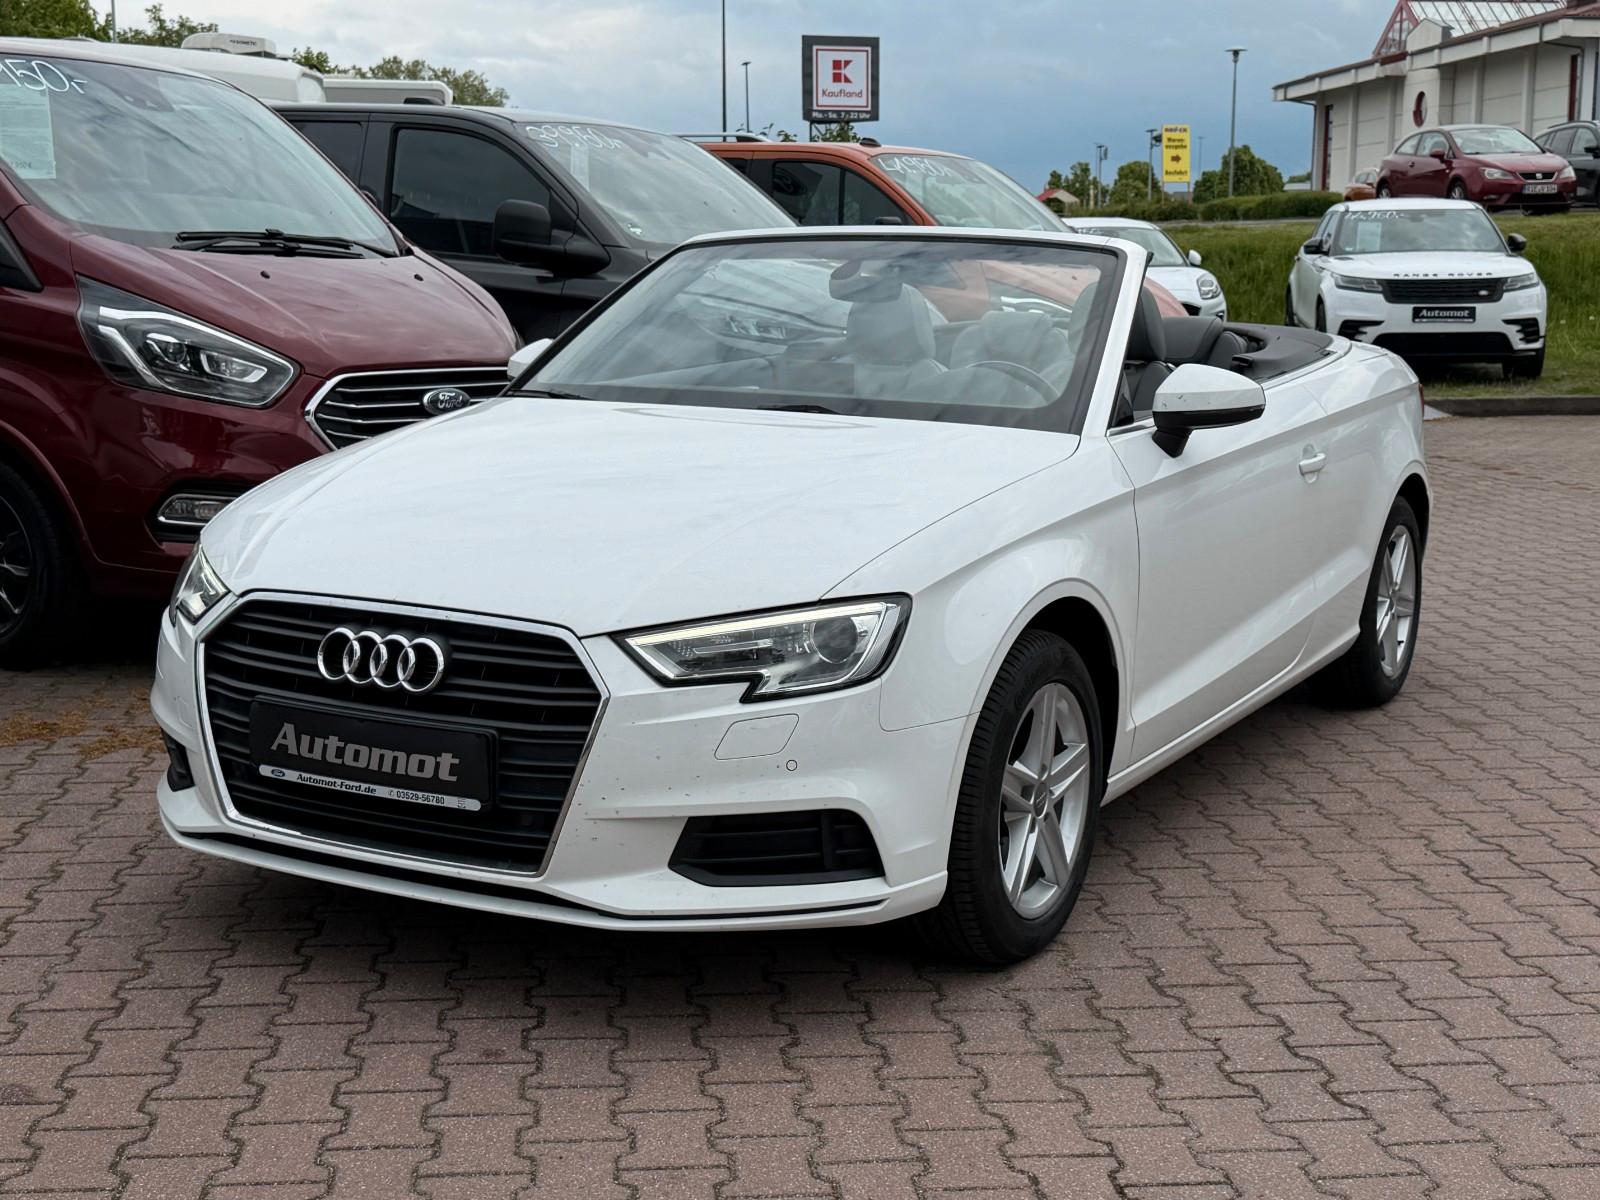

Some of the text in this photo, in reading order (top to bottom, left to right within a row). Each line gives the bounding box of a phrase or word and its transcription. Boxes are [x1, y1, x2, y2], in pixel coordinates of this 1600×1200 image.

[822, 89, 863, 98] Kaufland
[1418, 308, 1471, 317] Automot
[438, 392, 463, 409] Ford
[269, 721, 460, 782] Automot
[296, 773, 377, 795] Automot-Ford.de
[396, 790, 446, 805] 03529-56780
